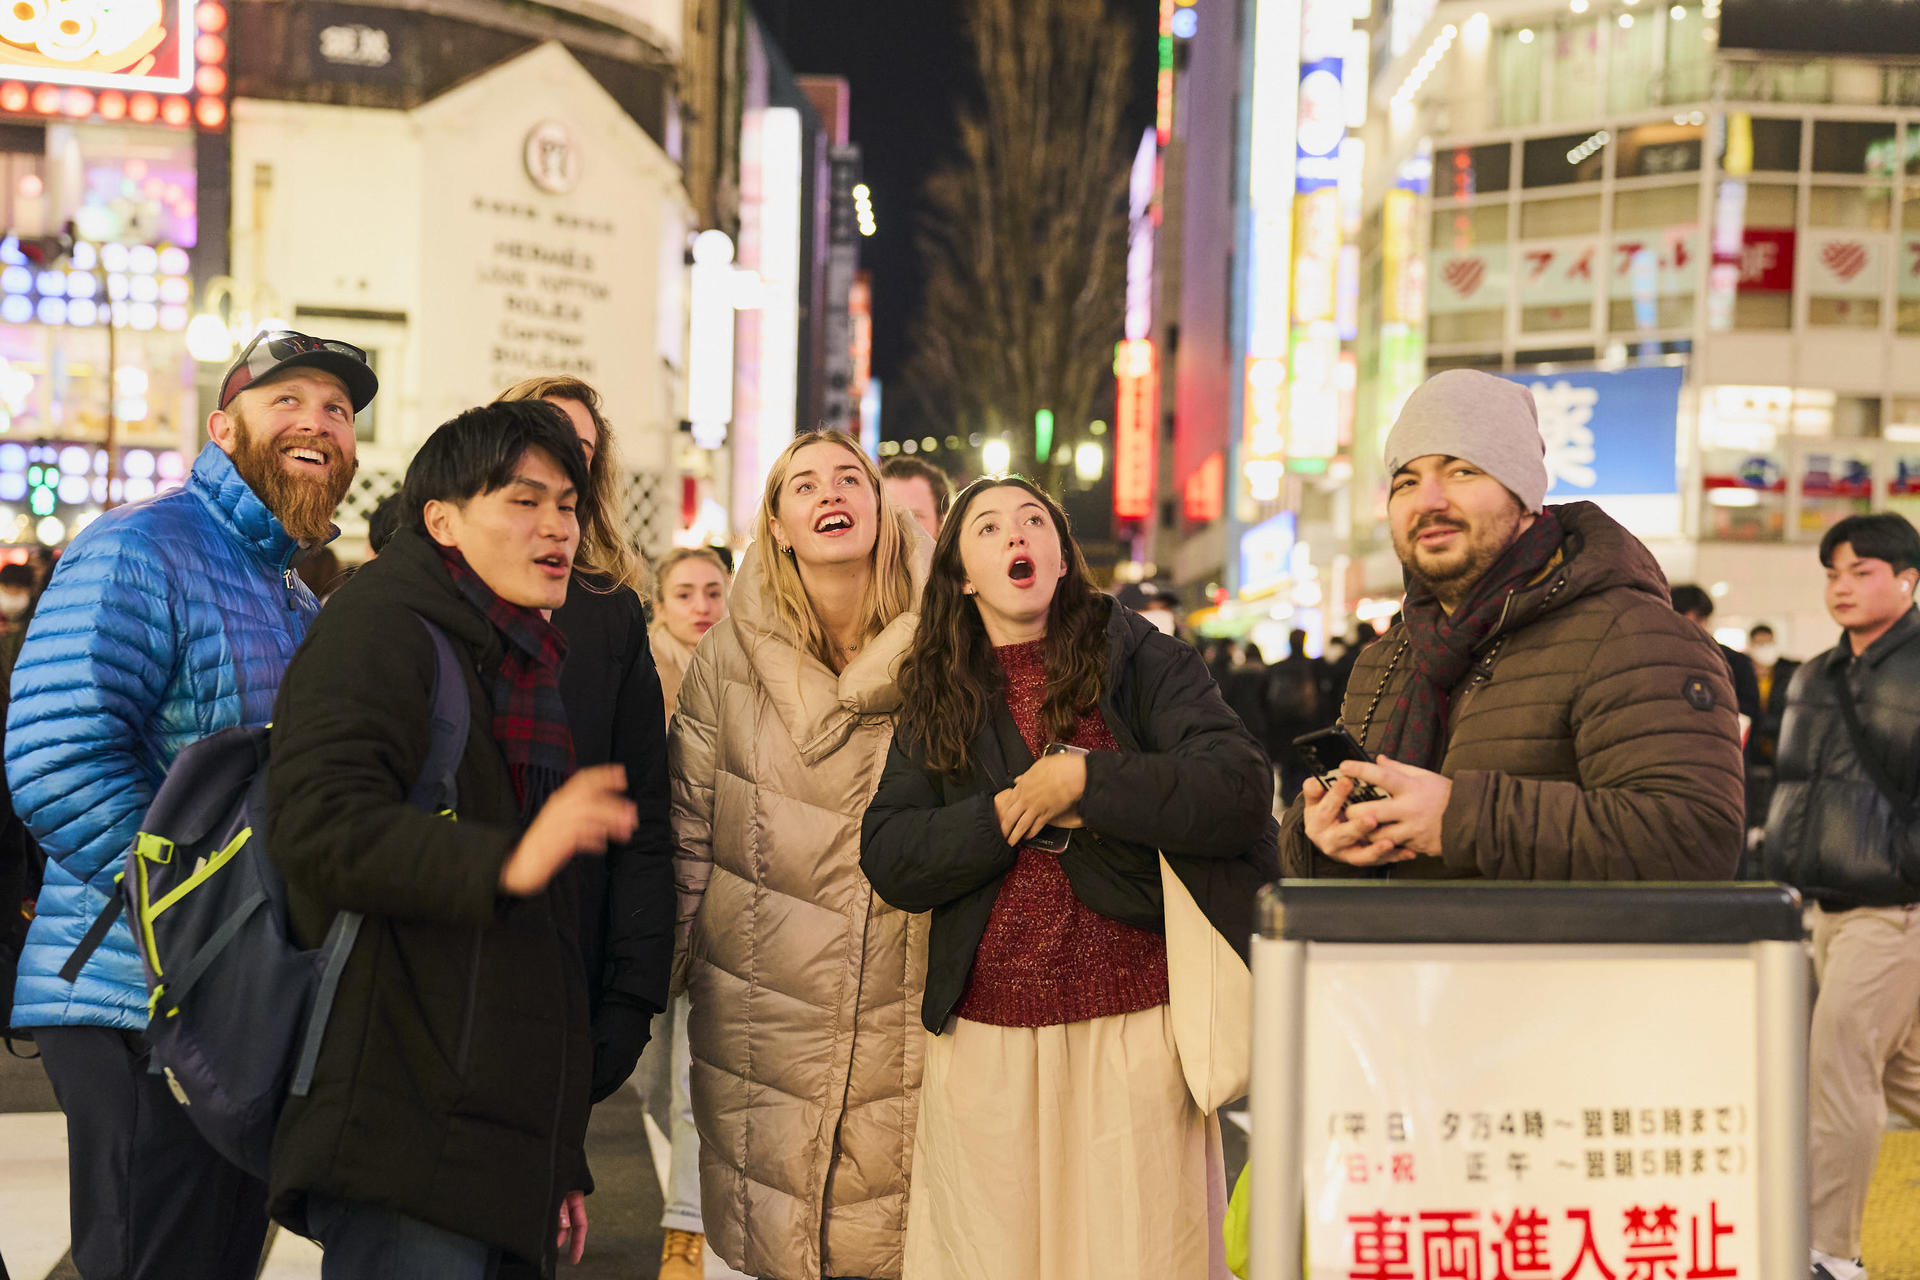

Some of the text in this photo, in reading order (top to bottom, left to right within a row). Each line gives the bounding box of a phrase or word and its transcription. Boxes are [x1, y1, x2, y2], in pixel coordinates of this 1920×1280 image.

[1347, 1201, 1738, 1280] 車両進入禁止
